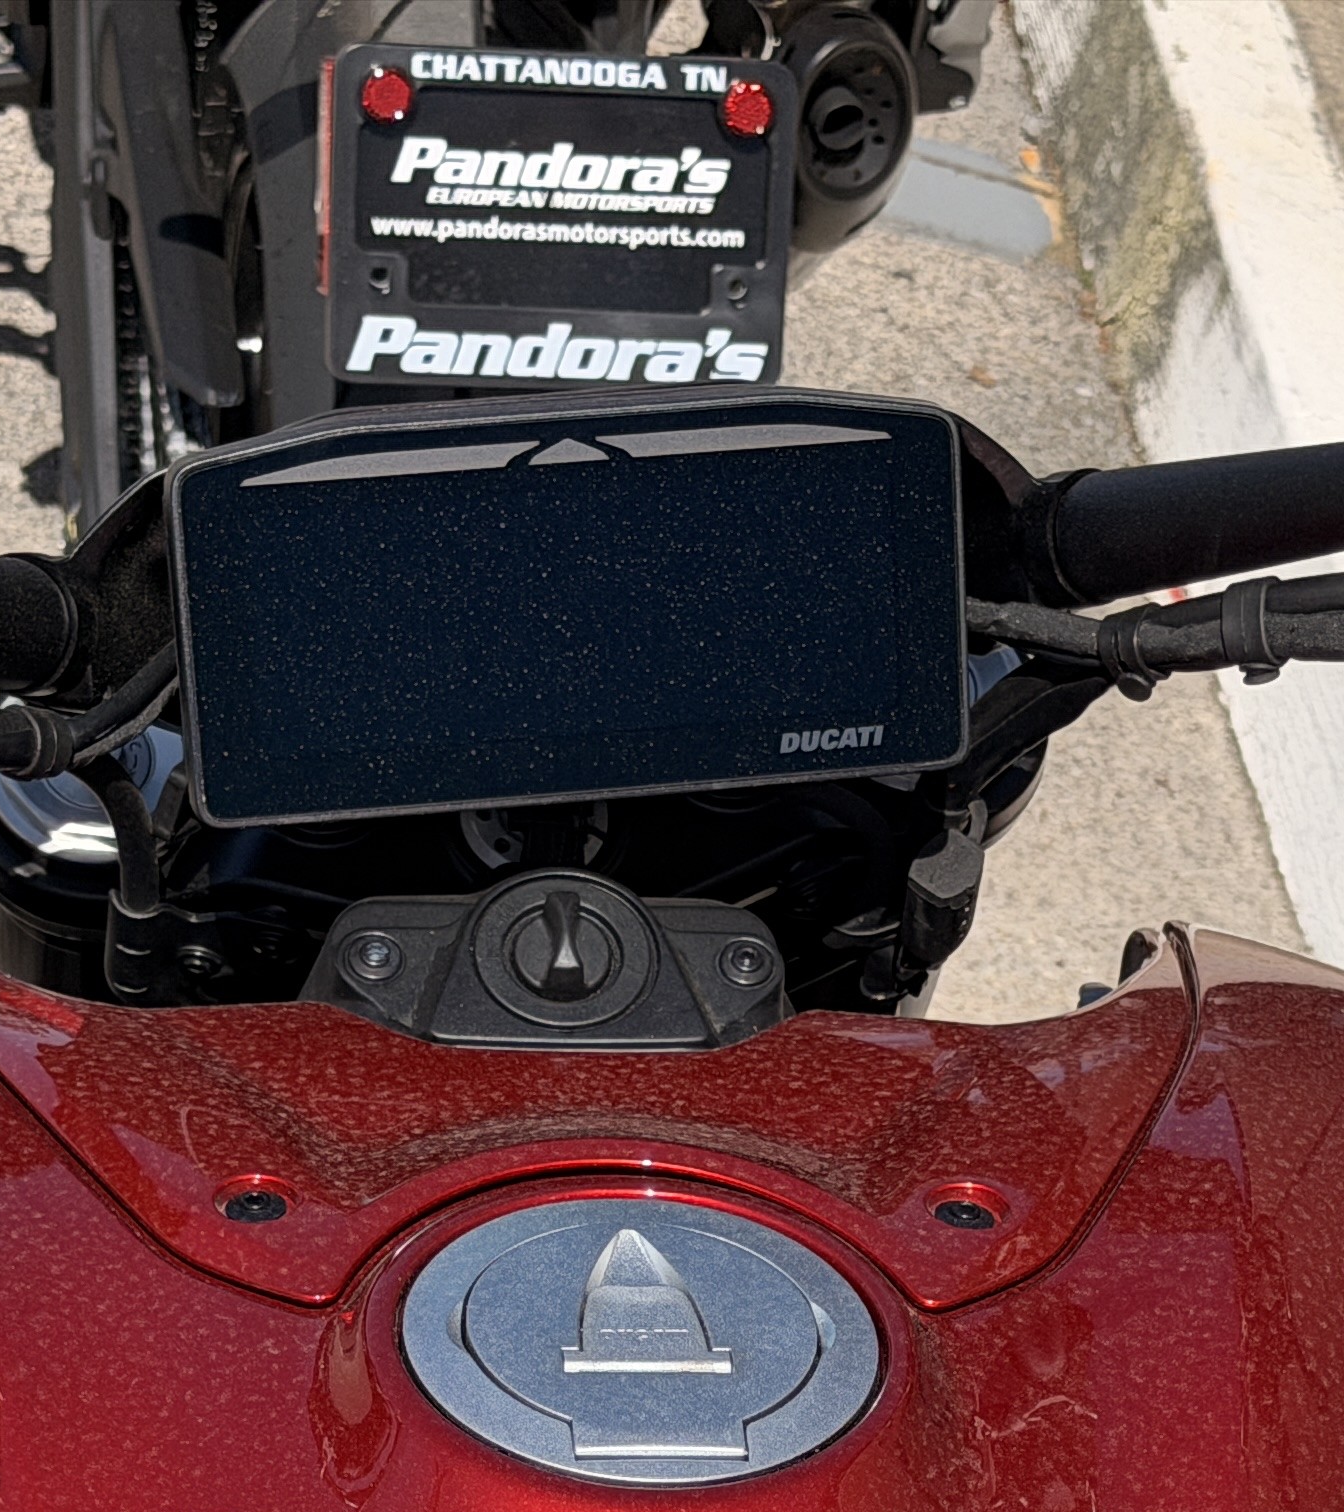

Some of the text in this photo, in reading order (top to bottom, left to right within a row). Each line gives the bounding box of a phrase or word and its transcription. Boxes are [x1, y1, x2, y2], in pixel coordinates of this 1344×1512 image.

[411, 52, 727, 92] CHATTANOOGA TN
[391, 136, 731, 194] Pandora's
[425, 187, 715, 215] EUROPEAN MOTORSPORTS
[370, 215, 745, 251] www.pandorasmotorsports.com
[346, 315, 768, 382] Pandora's
[780, 725, 884, 754] DUCATI
